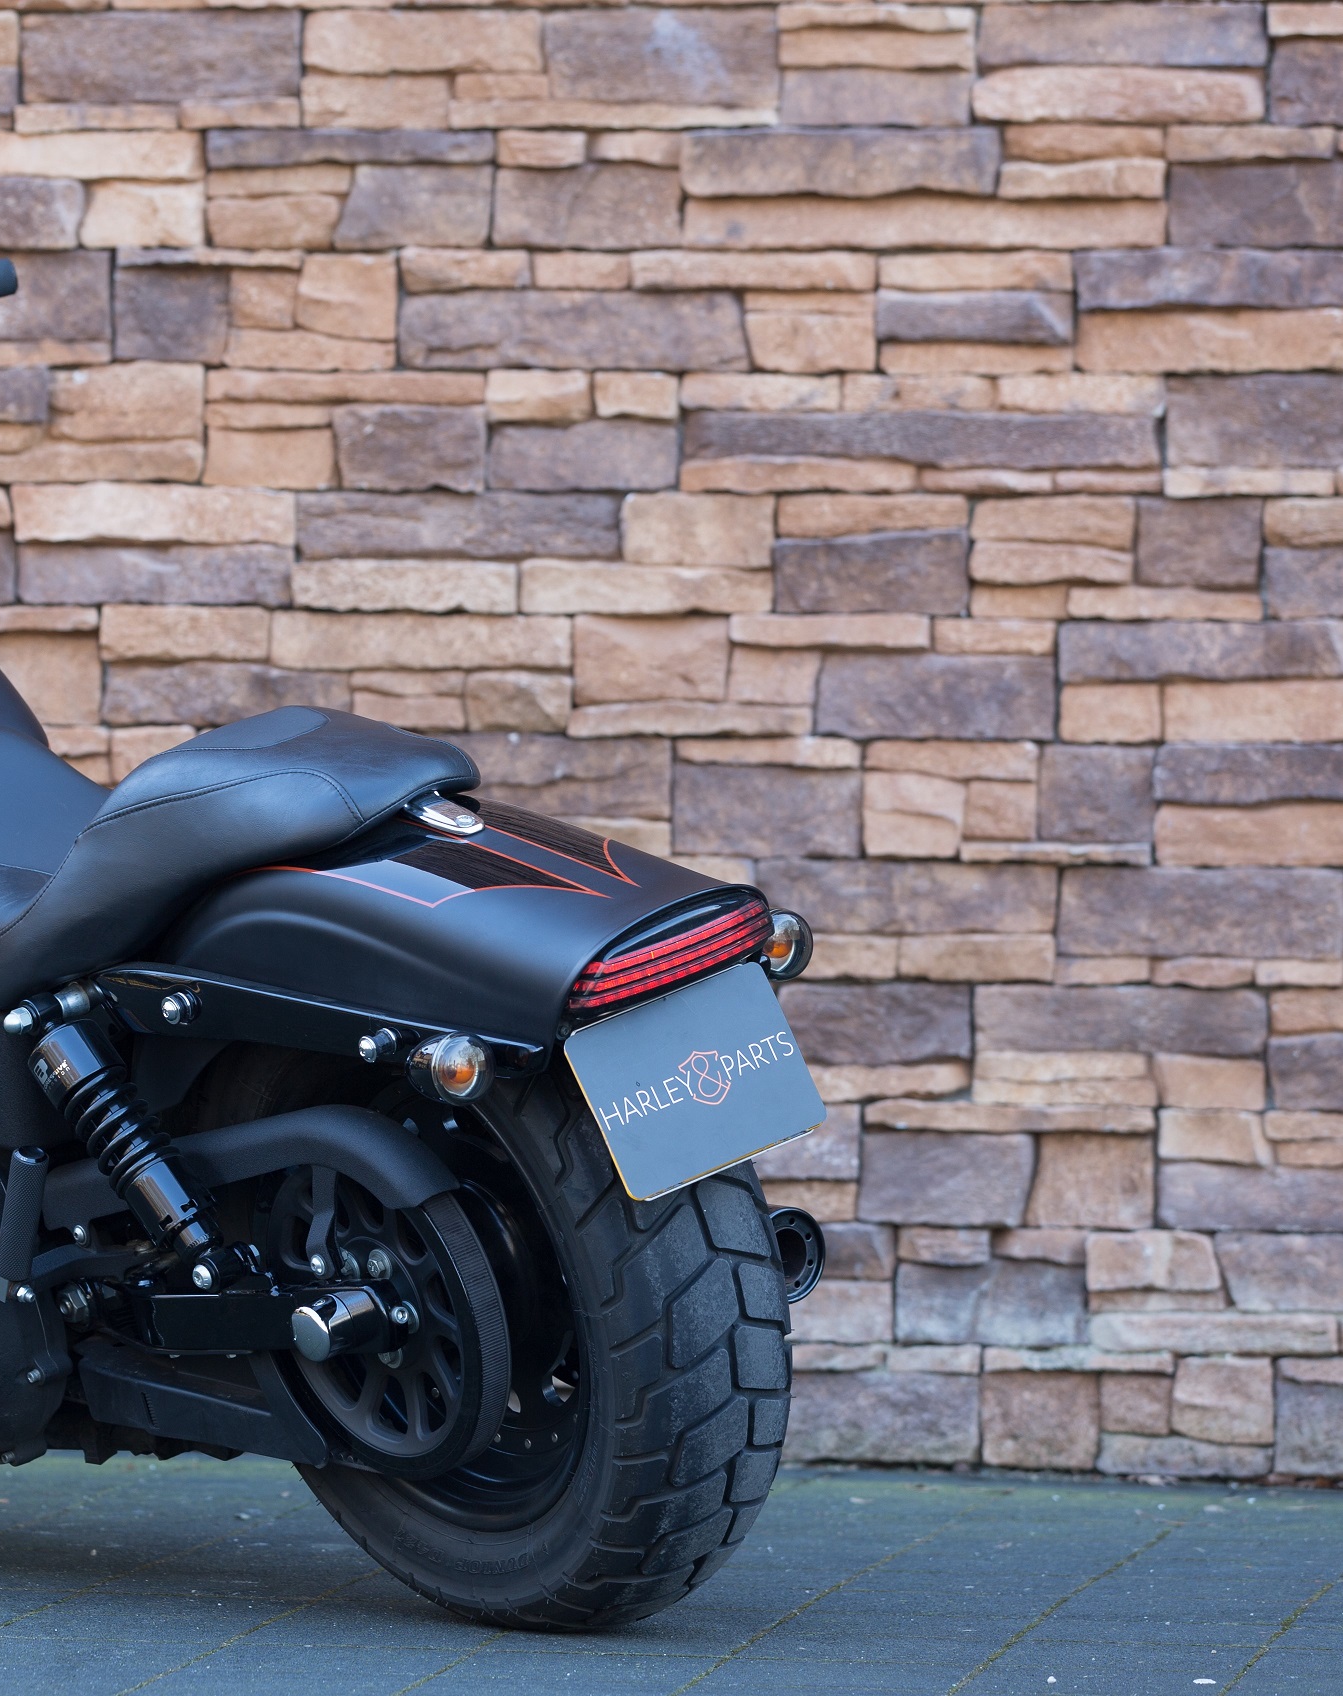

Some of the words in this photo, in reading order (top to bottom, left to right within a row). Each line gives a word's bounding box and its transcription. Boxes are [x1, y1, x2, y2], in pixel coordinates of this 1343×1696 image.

[598, 1070, 695, 1132] HARLEY
[719, 1031, 794, 1081] PARTS
[454, 1551, 532, 1575] DUNLOP
